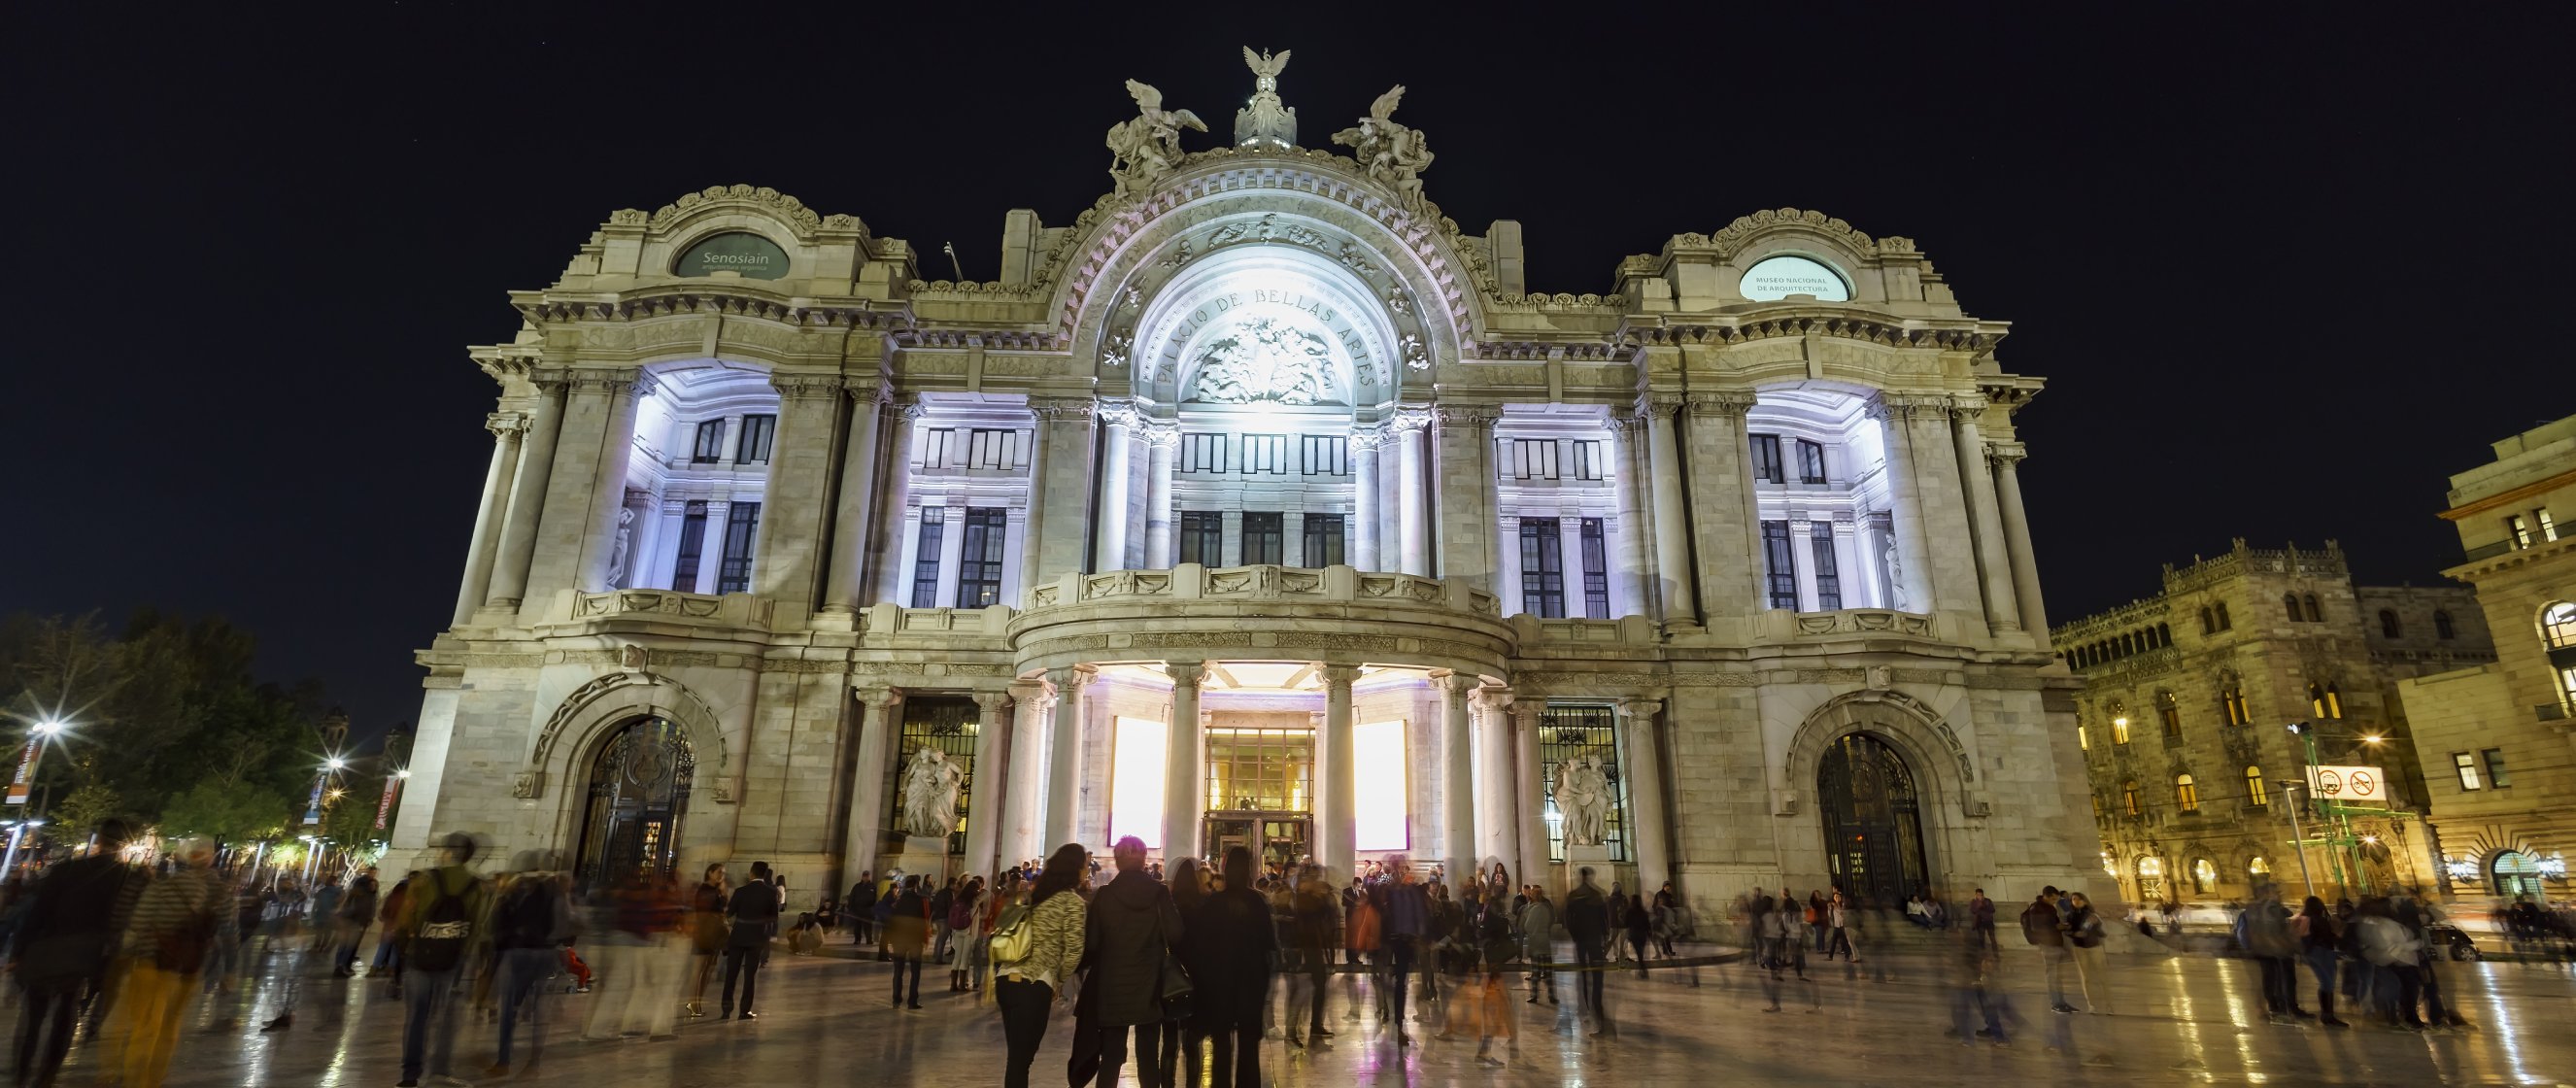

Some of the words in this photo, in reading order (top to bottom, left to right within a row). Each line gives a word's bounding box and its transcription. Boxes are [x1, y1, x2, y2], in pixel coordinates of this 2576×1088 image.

[702, 252, 769, 264] Senosiain
[1156, 309, 1207, 384] PALACIO
[1215, 292, 1243, 312] DE
[1255, 289, 1334, 322] BELLAS
[1337, 327, 1374, 387] ARTES
